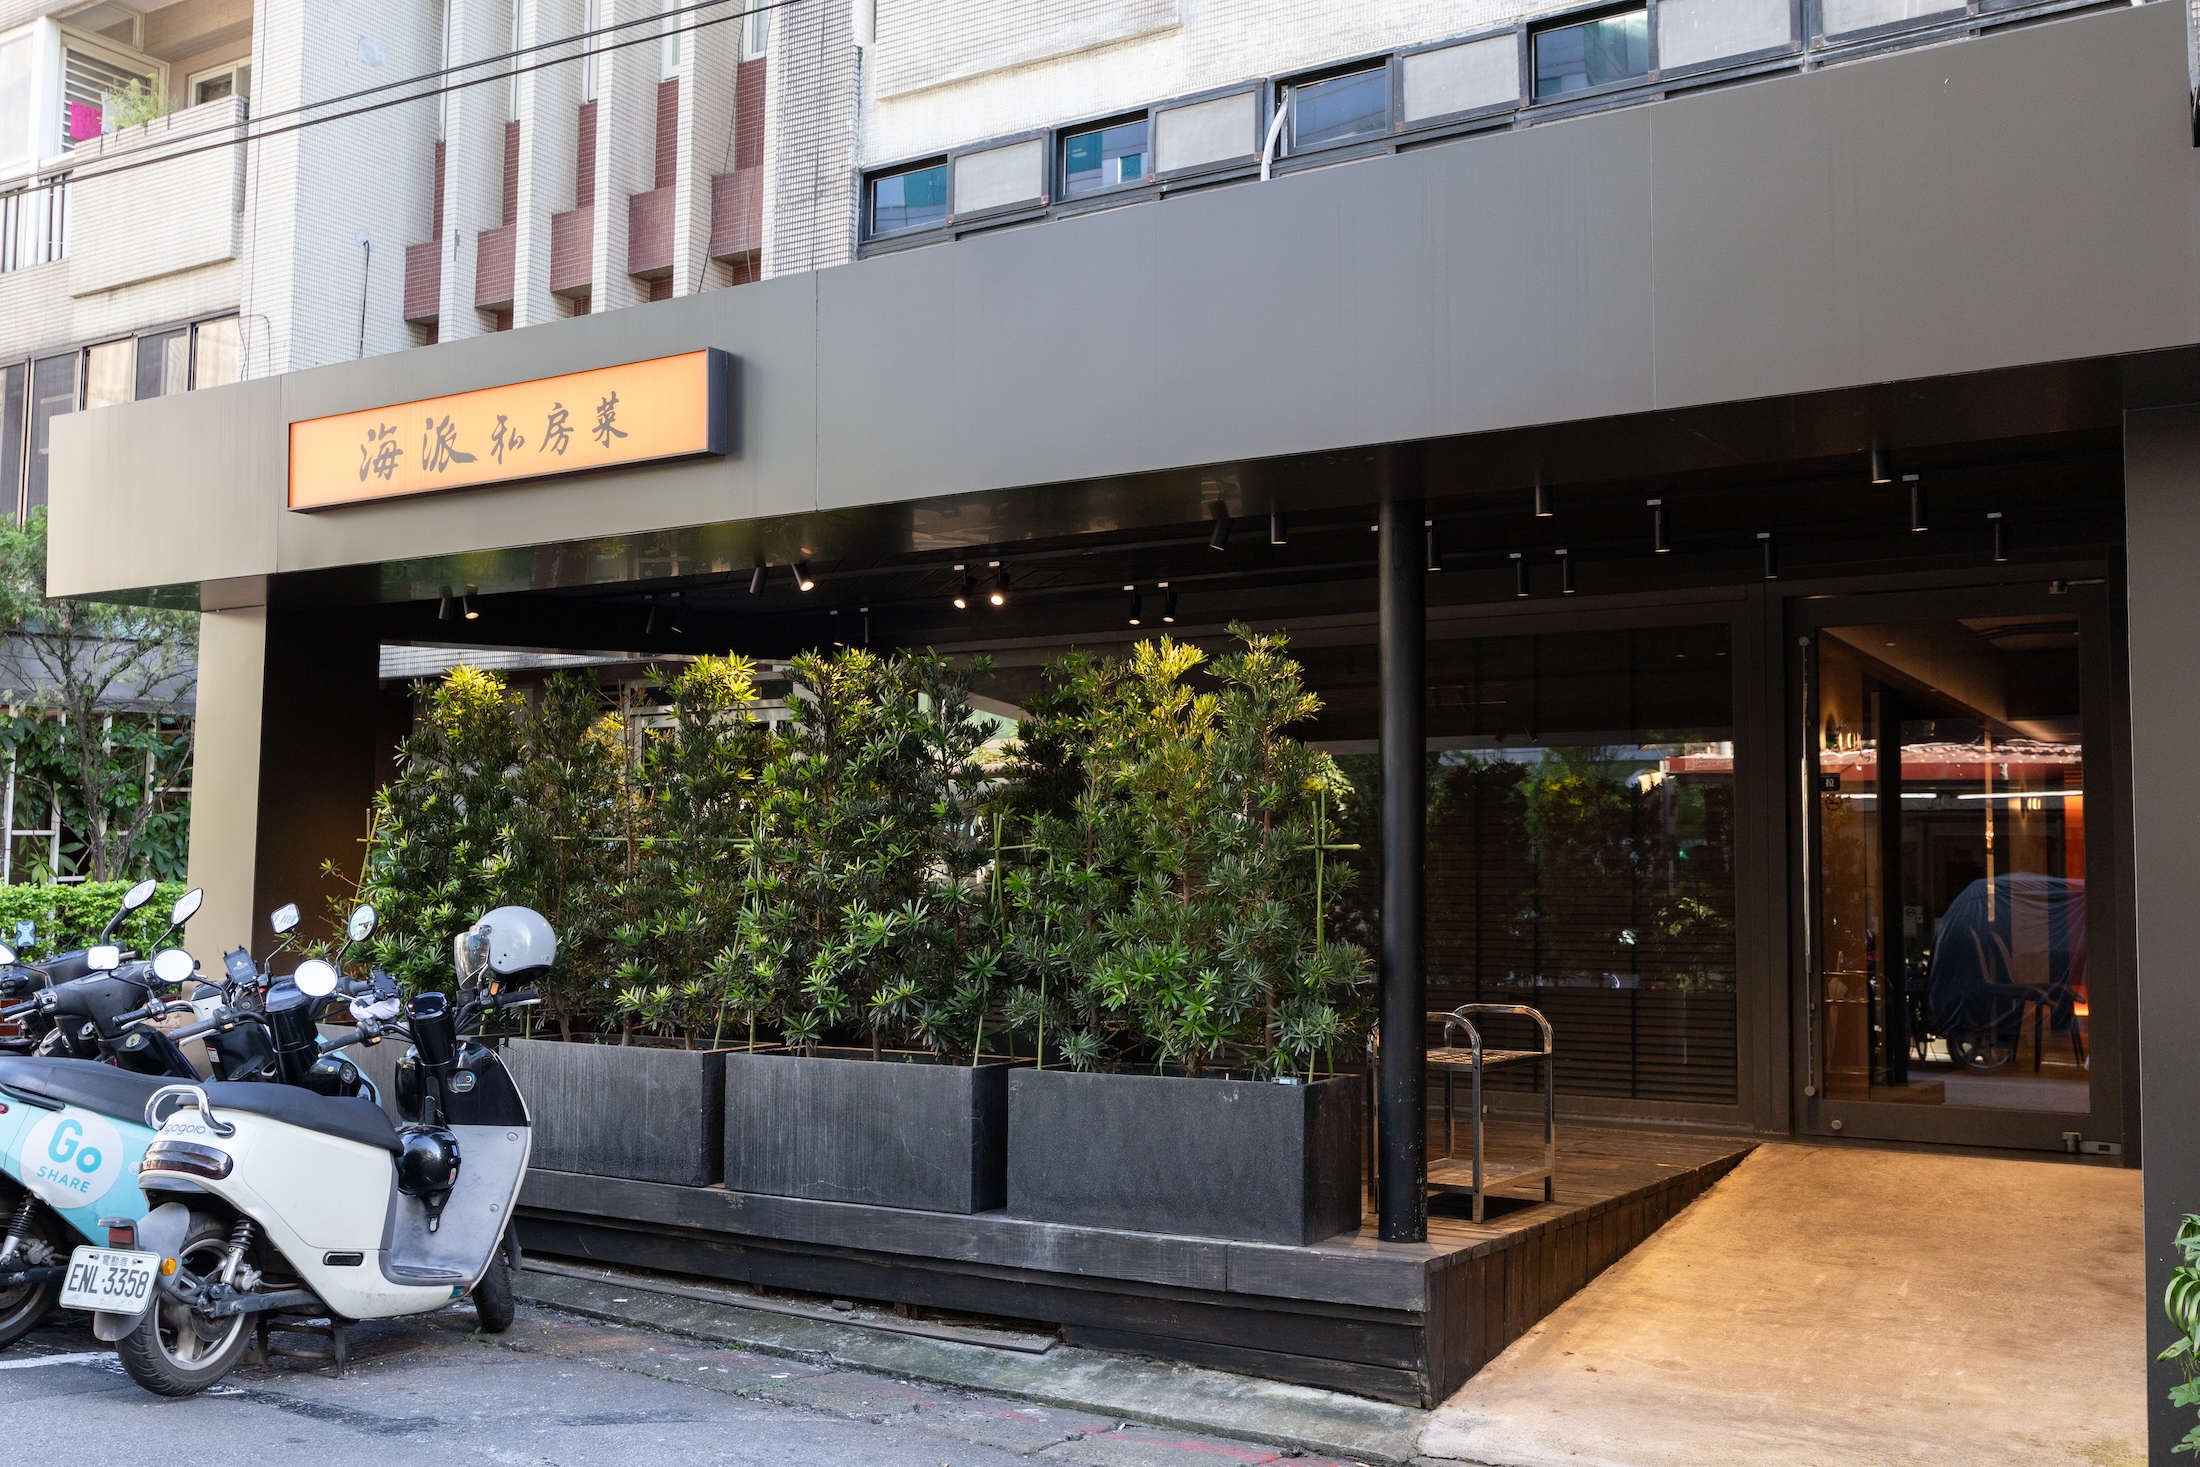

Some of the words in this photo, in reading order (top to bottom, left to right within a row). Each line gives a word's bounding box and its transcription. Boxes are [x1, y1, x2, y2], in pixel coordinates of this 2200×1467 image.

[359, 391, 628, 482] 海派私房菜
[48, 1118, 102, 1173] Go
[164, 1123, 206, 1135] gogoro
[37, 1165, 91, 1193] SHARE
